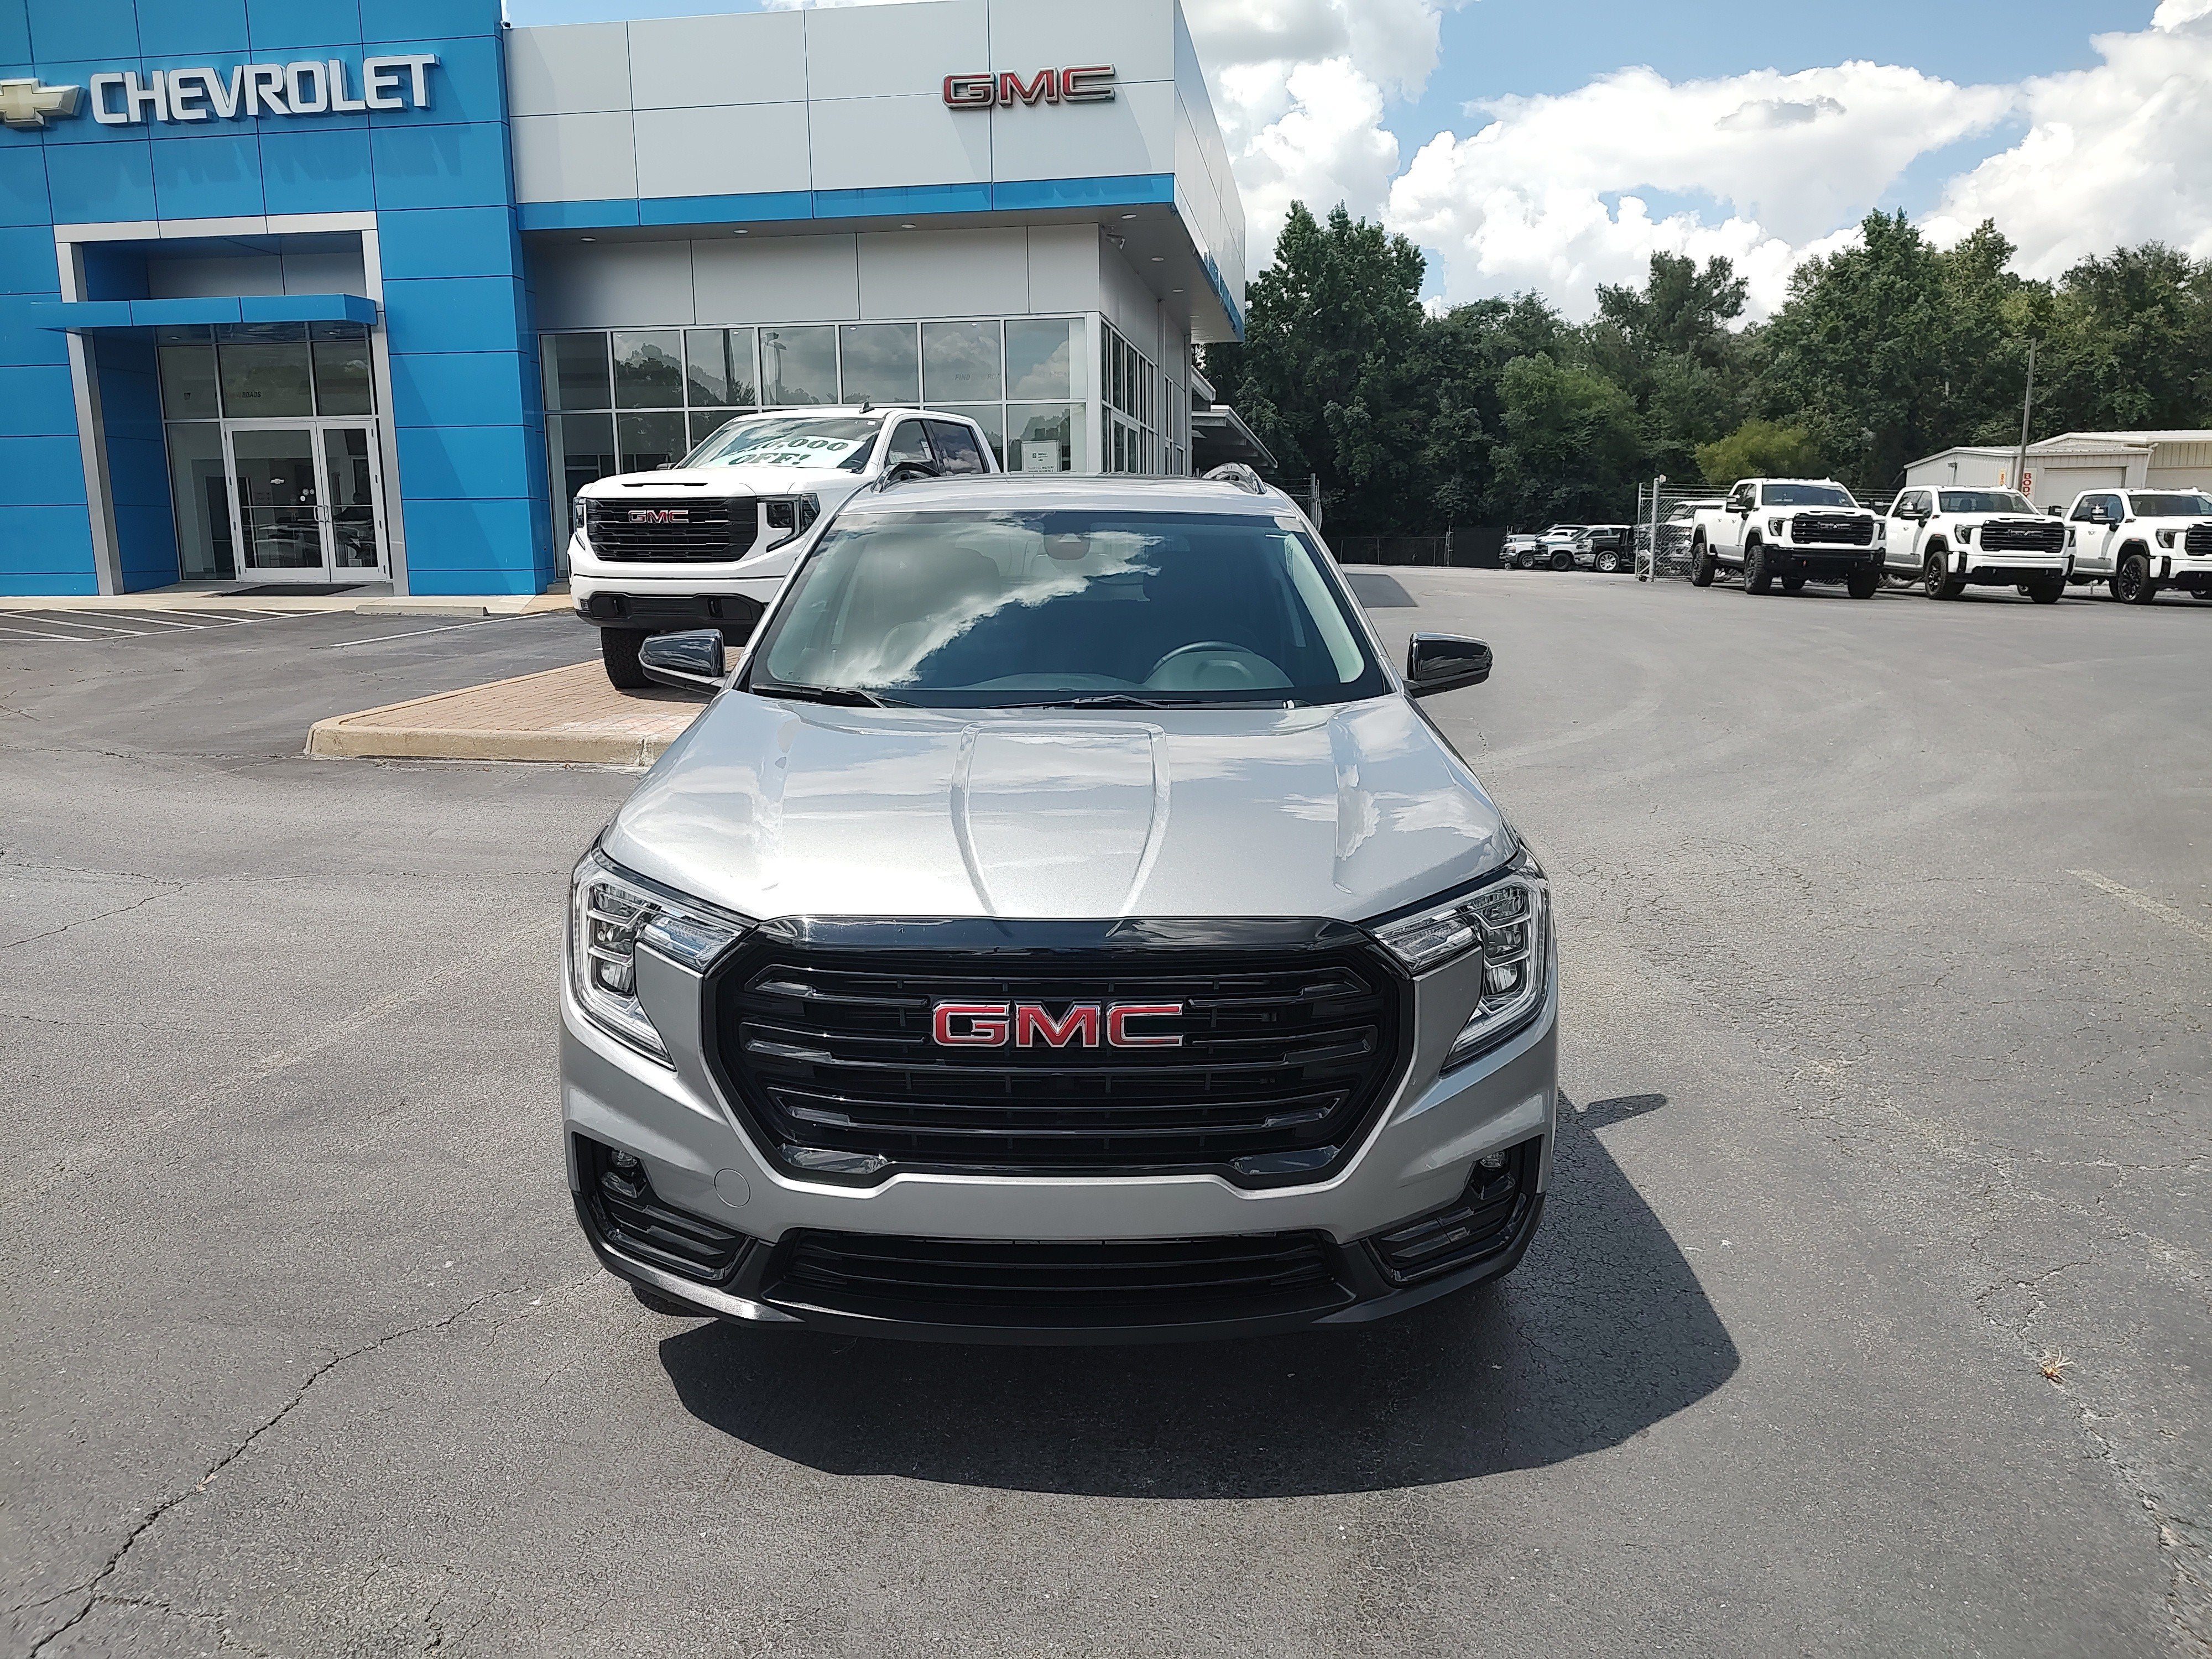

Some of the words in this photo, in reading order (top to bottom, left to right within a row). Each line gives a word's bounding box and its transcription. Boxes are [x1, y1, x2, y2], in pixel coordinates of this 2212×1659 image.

[90, 54, 440, 124] CHEVROLET
[942, 63, 1115, 108] GMC
[728, 453, 811, 465] OFF!
[628, 509, 689, 523] GMC
[932, 1001, 1183, 1047] GMC
